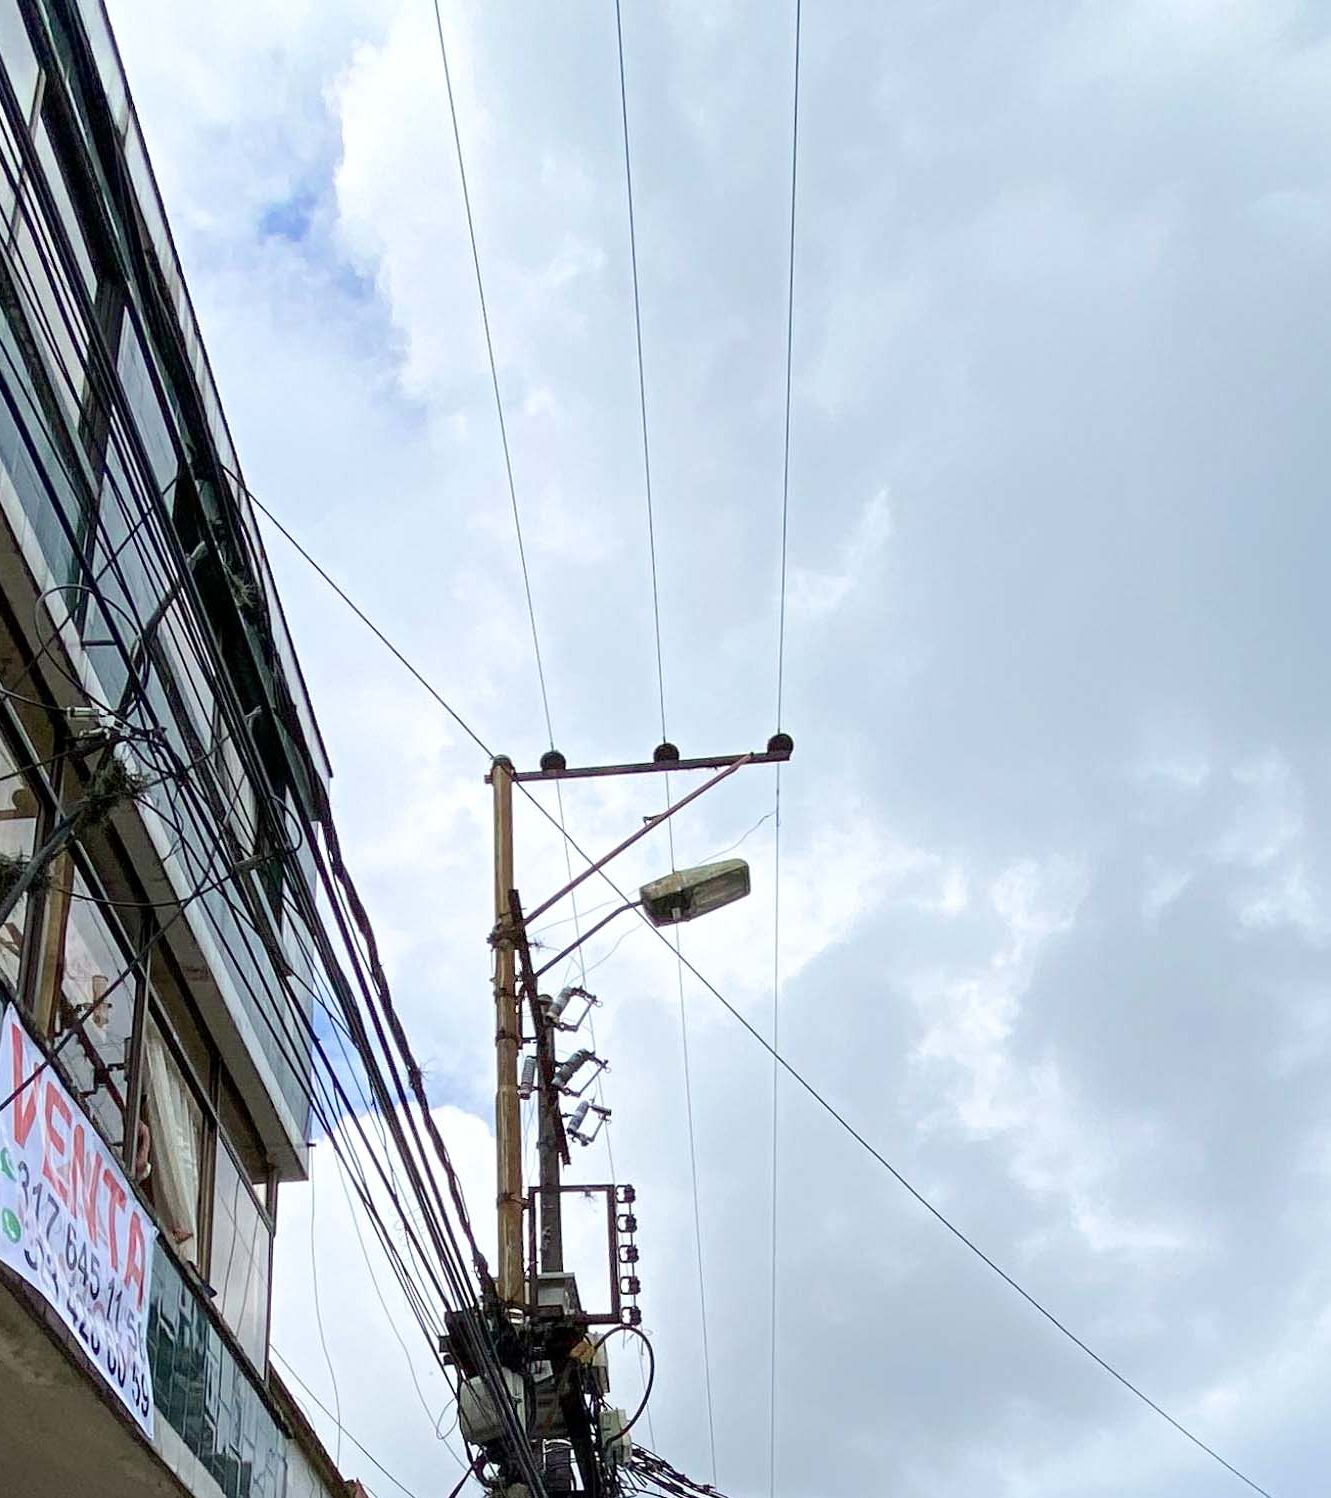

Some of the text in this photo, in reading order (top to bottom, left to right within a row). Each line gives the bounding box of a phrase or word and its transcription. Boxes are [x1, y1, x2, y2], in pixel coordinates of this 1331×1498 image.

[11, 1022, 146, 1312] VENTA
[18, 1161, 59, 1240] 317
[67, 1223, 100, 1300] 645
[106, 1277, 123, 1330] 11
[131, 1361, 150, 1418] 59
